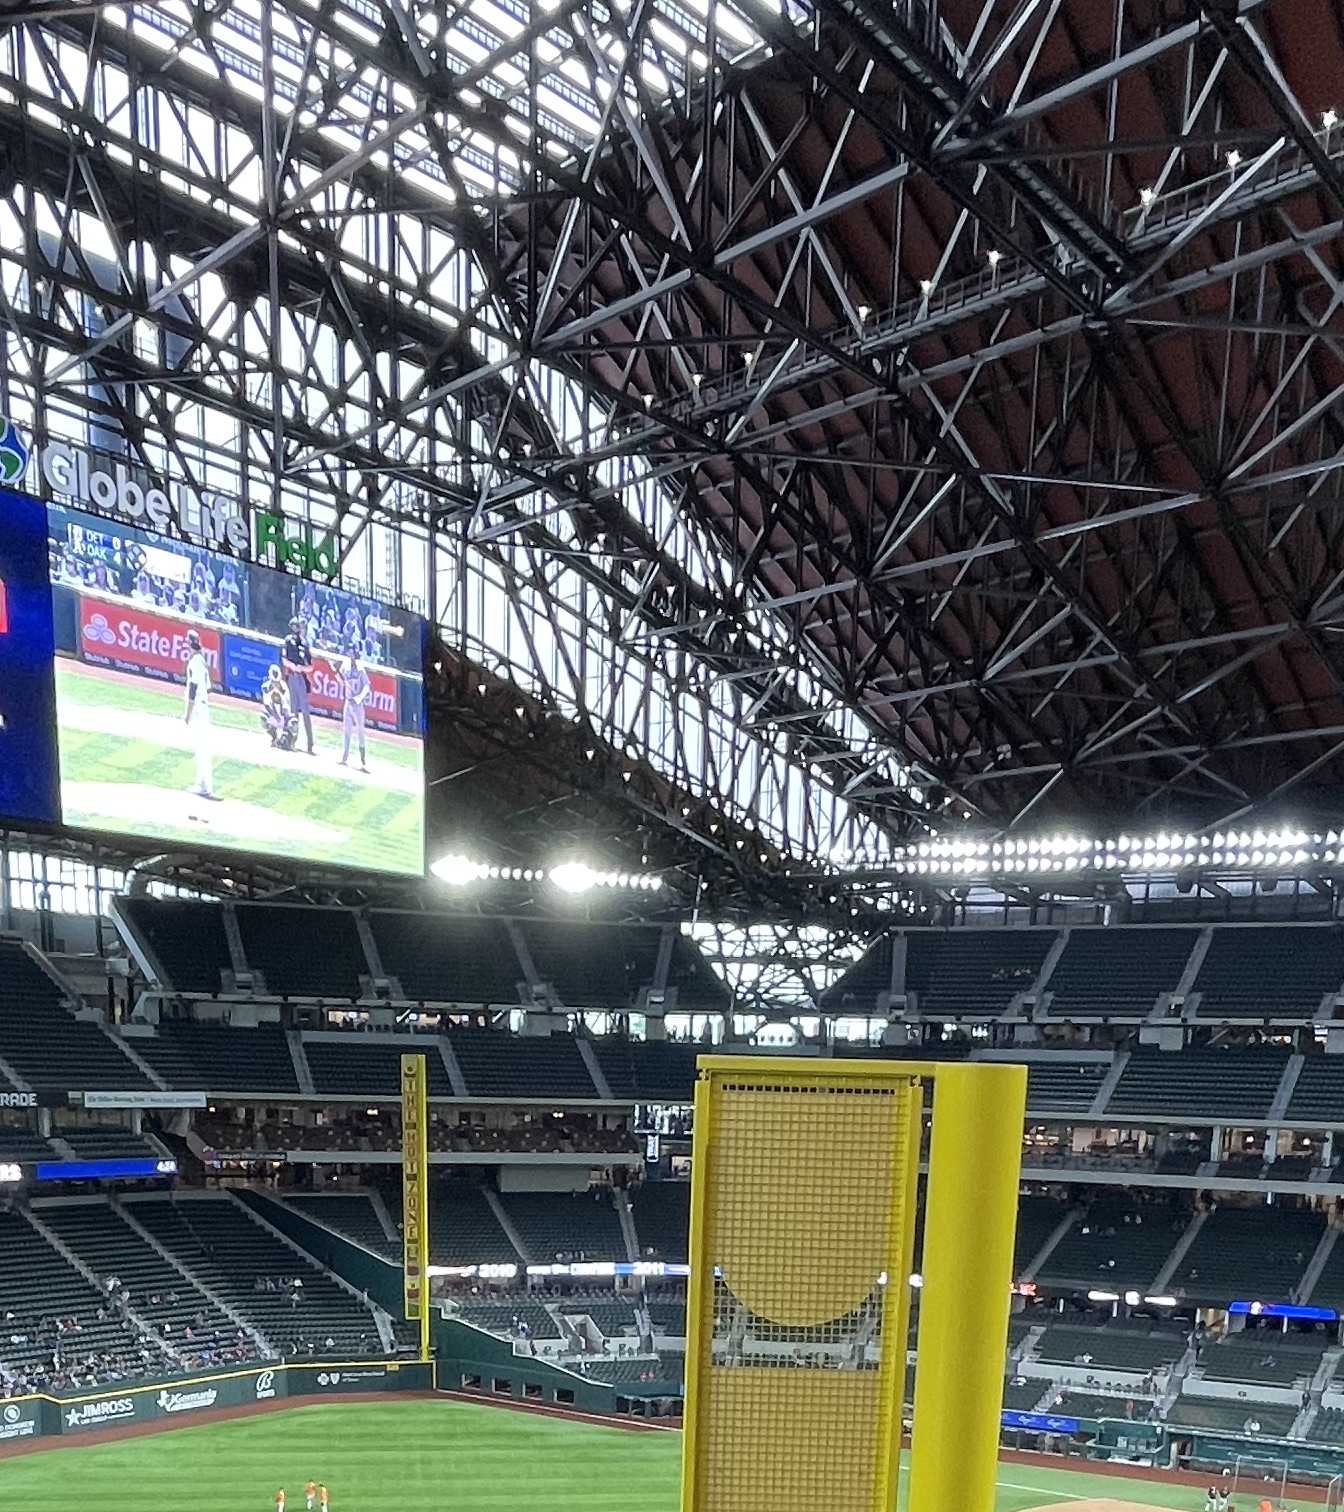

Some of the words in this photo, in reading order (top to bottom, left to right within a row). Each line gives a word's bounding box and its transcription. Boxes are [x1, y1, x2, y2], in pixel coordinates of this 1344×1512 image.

[43, 443, 172, 527] Globe
[170, 482, 249, 550] Life
[256, 510, 340, 580] Field
[86, 529, 104, 545] DET
[87, 543, 107, 560] OAK
[478, 1263, 518, 1278] 2010
